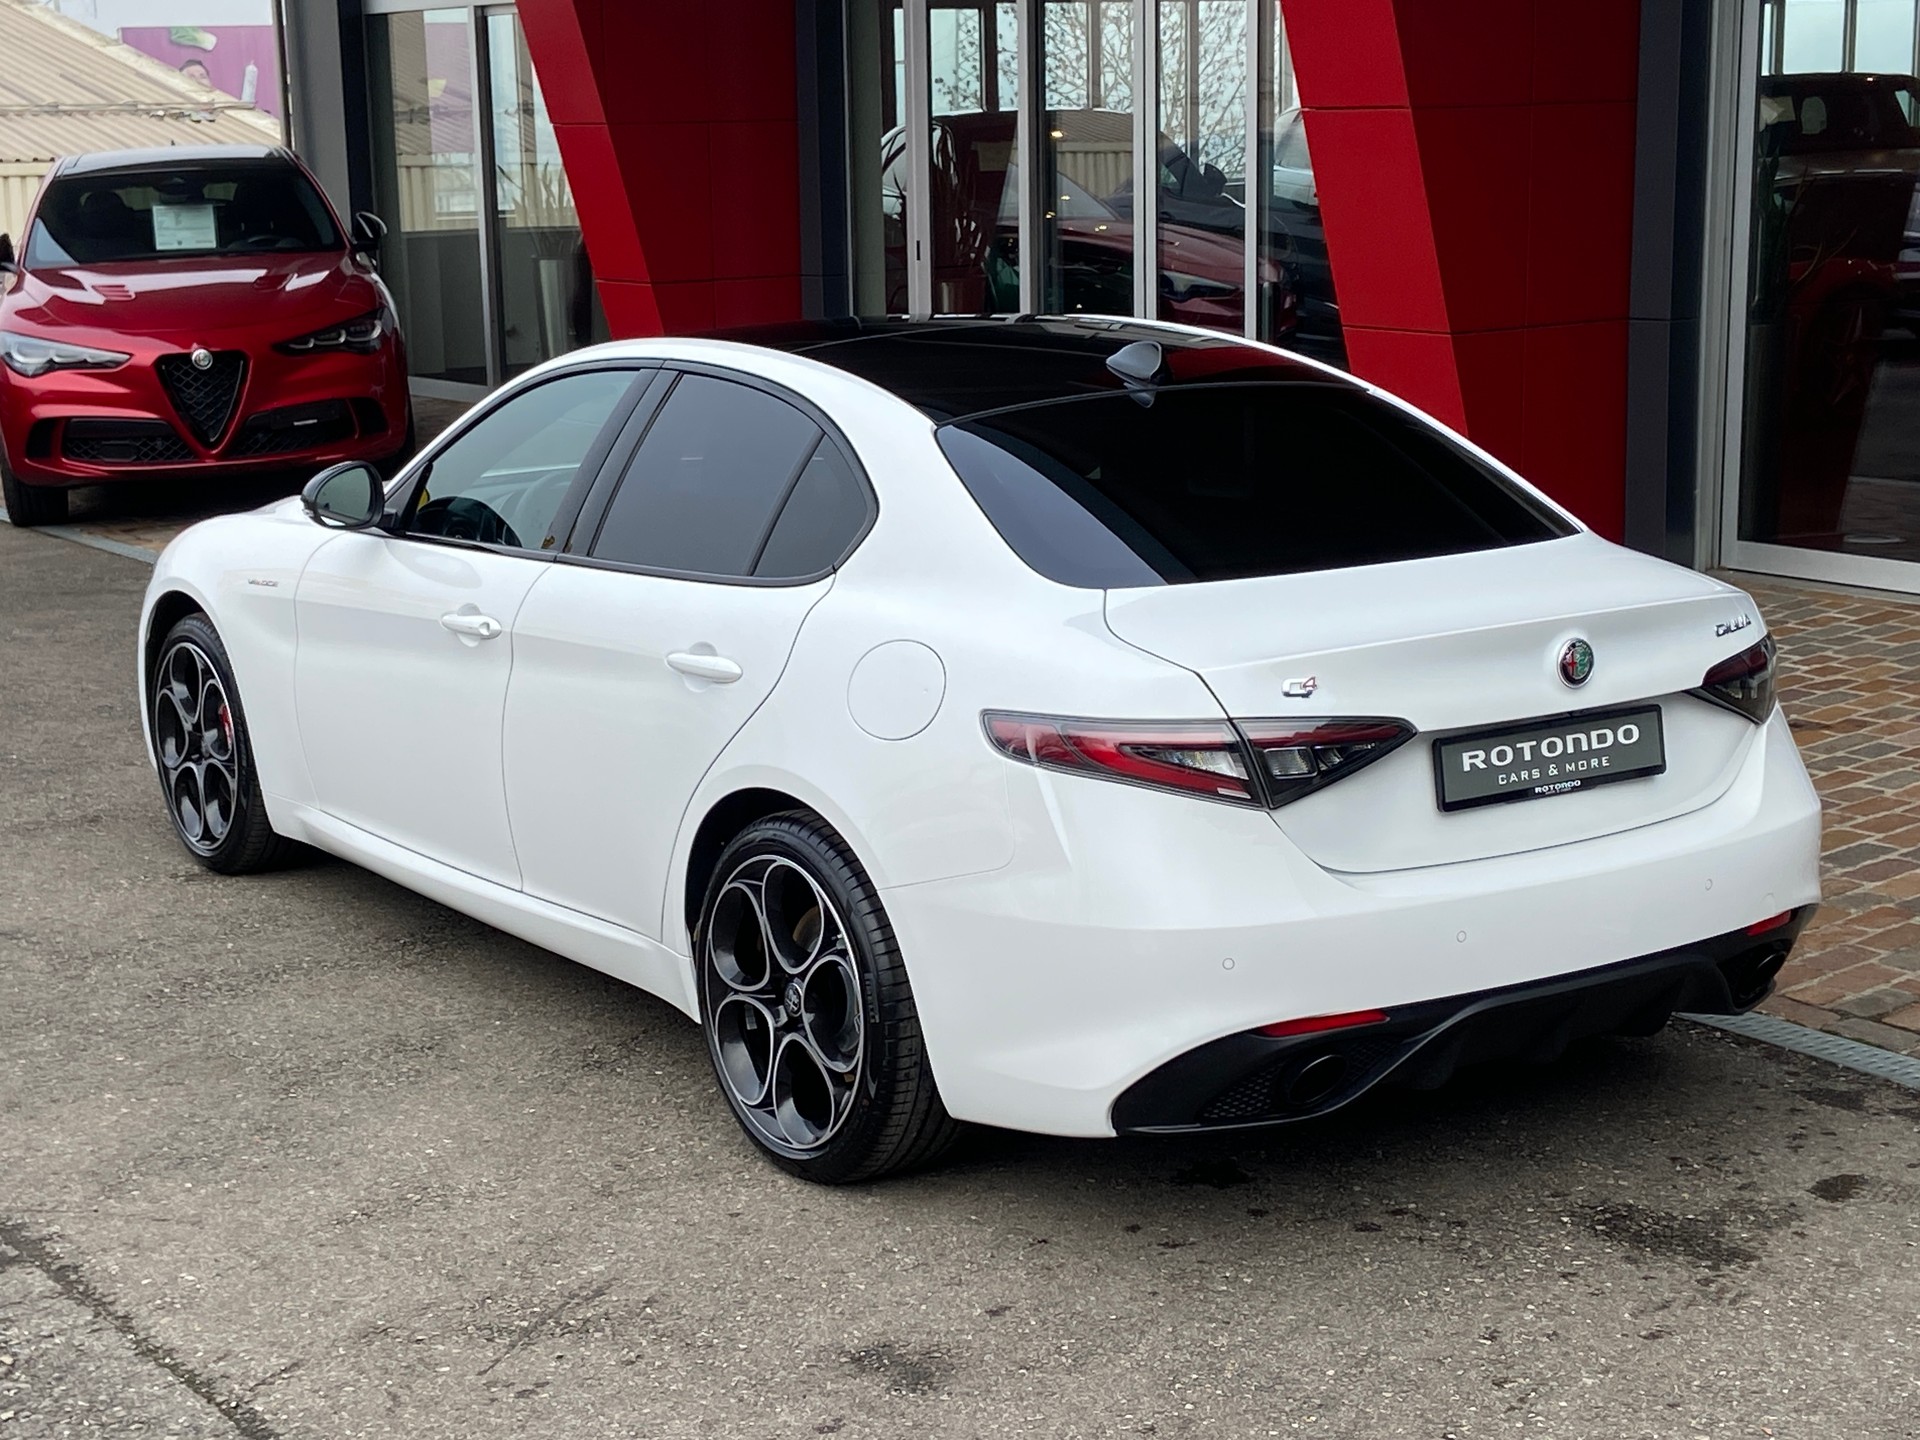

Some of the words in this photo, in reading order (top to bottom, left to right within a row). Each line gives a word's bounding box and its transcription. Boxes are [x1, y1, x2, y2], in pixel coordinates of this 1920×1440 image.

[1281, 676, 1317, 698] Q4
[1462, 724, 1640, 771] ROTONDO
[1498, 768, 1541, 785] CARS
[1548, 764, 1559, 776] &
[1565, 756, 1610, 772] MORE
[1535, 780, 1581, 793] ROTONDO
